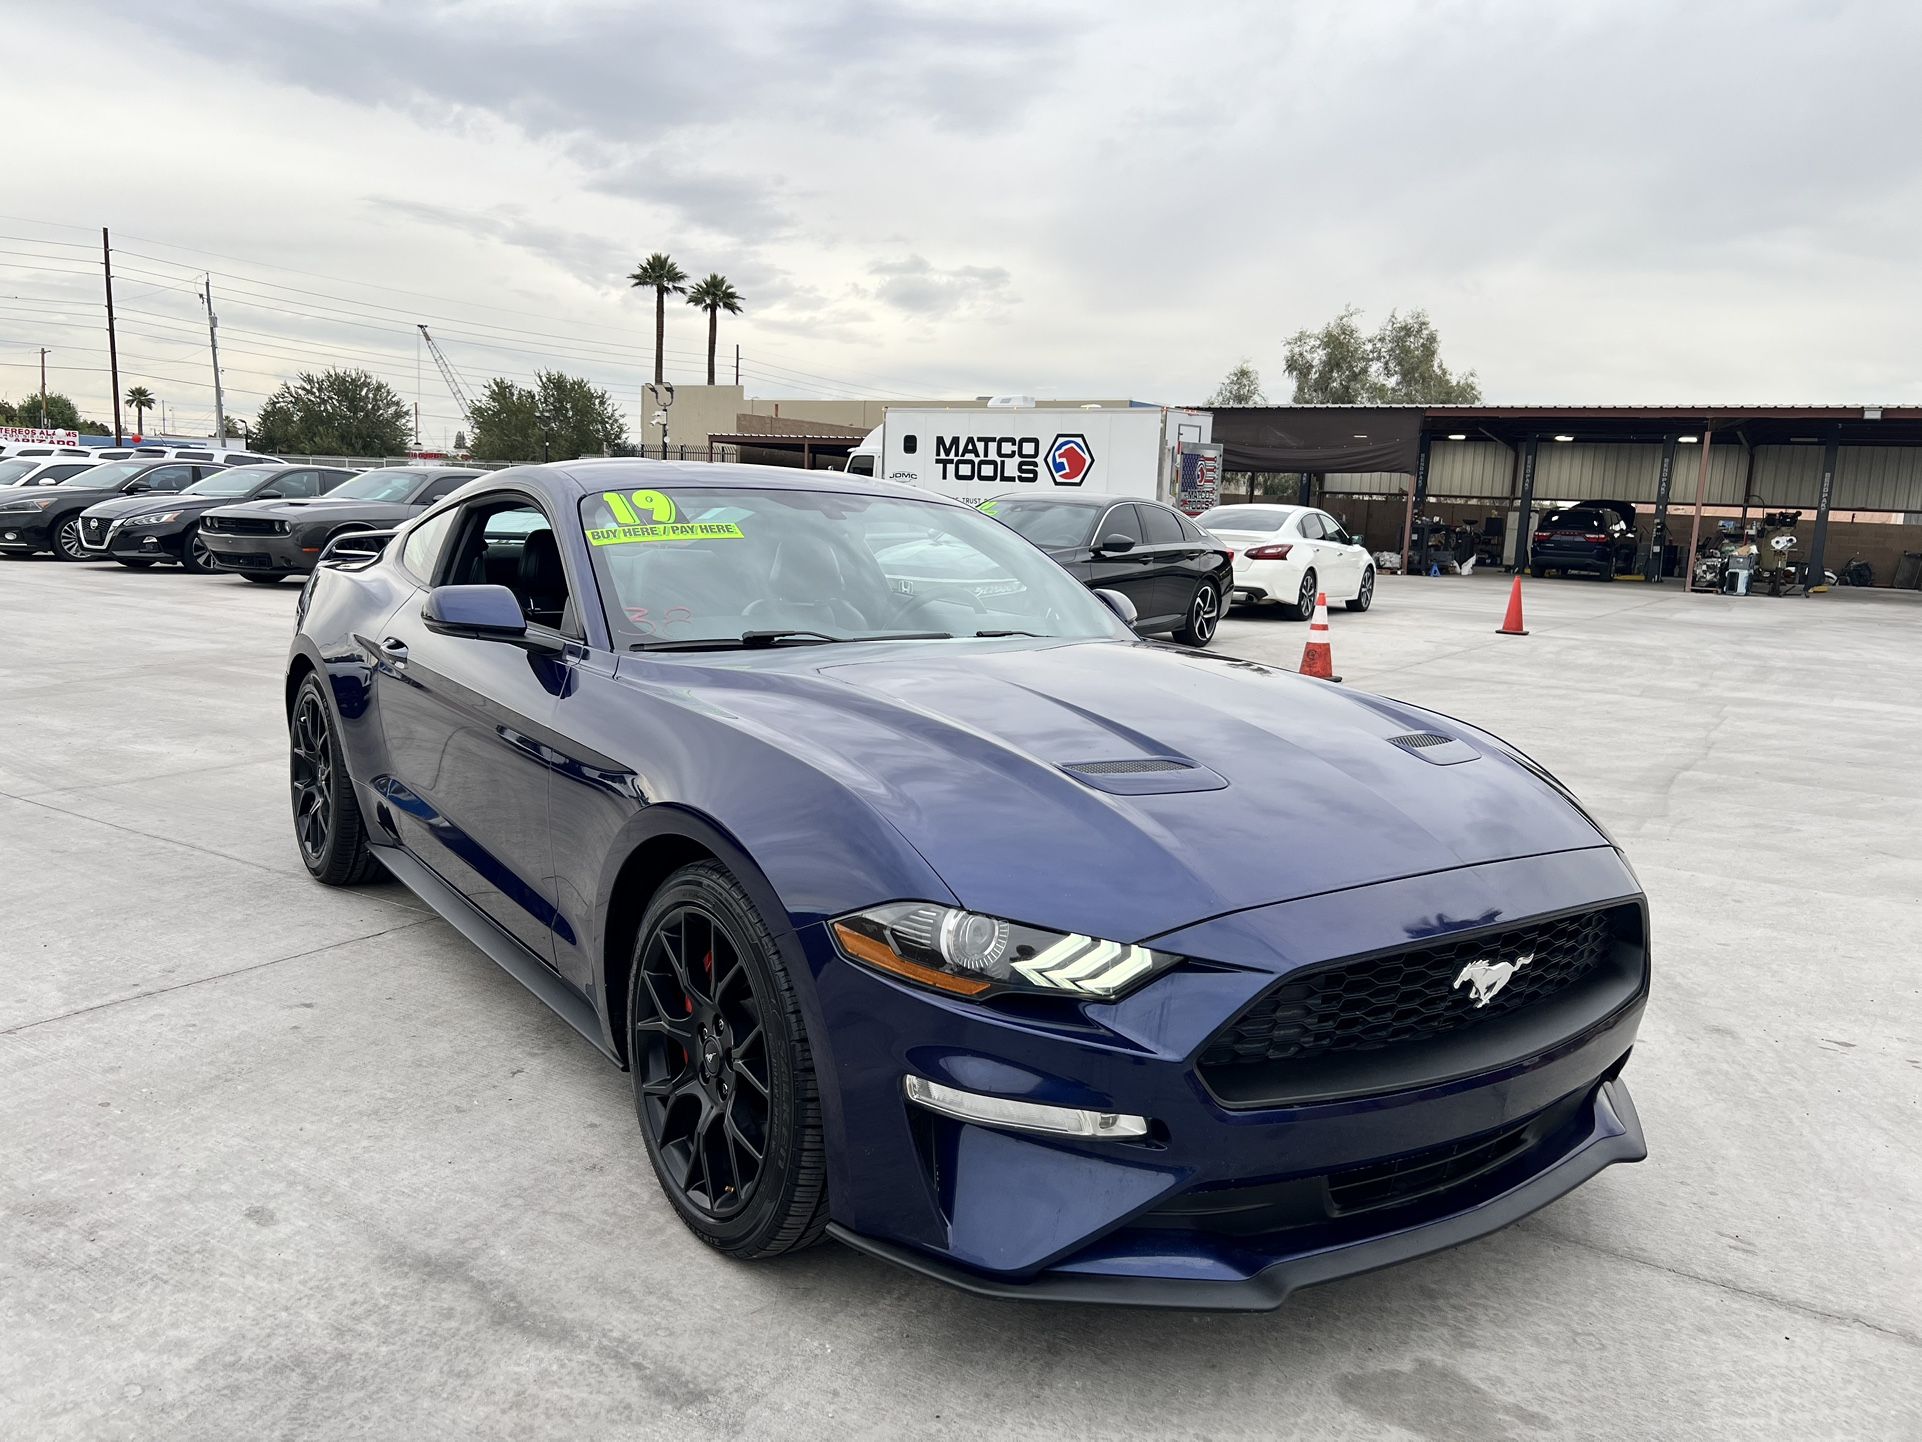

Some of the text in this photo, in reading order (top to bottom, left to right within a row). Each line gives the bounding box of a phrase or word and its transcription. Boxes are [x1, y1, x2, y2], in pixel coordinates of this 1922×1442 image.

[935, 436, 1040, 459] MATCO
[934, 458, 1039, 483] TOOLS
[602, 489, 677, 525] 19
[591, 529, 618, 541] BUY
[623, 526, 660, 538] HERE
[671, 524, 697, 536] PAY
[700, 523, 735, 535] HERE
